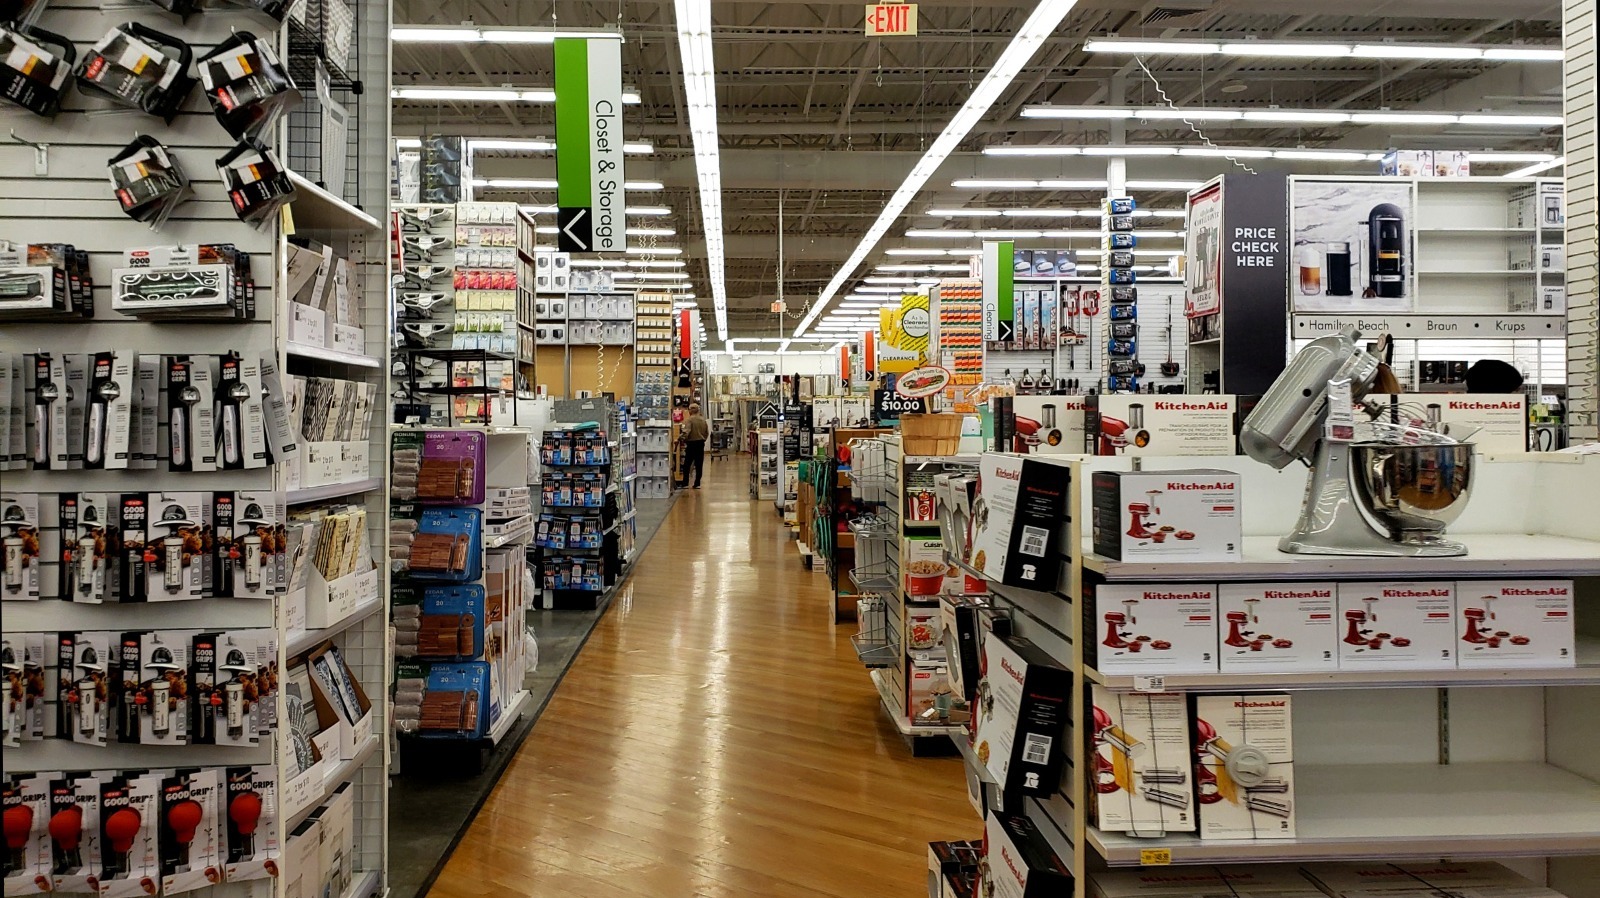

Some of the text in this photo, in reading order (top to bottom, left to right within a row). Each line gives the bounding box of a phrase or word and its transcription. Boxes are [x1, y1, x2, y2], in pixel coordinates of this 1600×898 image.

[875, 5, 909, 33] EXIT
[595, 100, 617, 249] Closet & Storage
[1235, 227, 1276, 239] PRICE
[1231, 241, 1279, 253] CHECK
[129, 257, 150, 265] GOOD
[1236, 255, 1274, 267] HERE
[984, 302, 996, 340] Cleaning
[1358, 319, 1390, 331] Beach
[1427, 320, 1458, 331] Braun
[1495, 320, 1526, 334] Krups
[883, 391, 891, 400] 2
[881, 401, 920, 411] $10.00
[1154, 401, 1228, 410] KitchenAid
[1449, 401, 1521, 410] KitchenAid
[1167, 482, 1235, 490] KitchenAid
[1143, 591, 1211, 600] KitchenAid
[1264, 590, 1331, 599] KitchenAid
[1383, 589, 1449, 598] KitchenAid
[1501, 587, 1568, 596] KitchenAid
[230, 782, 252, 791] GOOD
[252, 780, 274, 789] GRIPS
[22, 792, 47, 802] GRIPS
[53, 795, 97, 803] GOOD GRIPS
[165, 790, 190, 802] GOOD
[103, 797, 129, 807] GOOD
